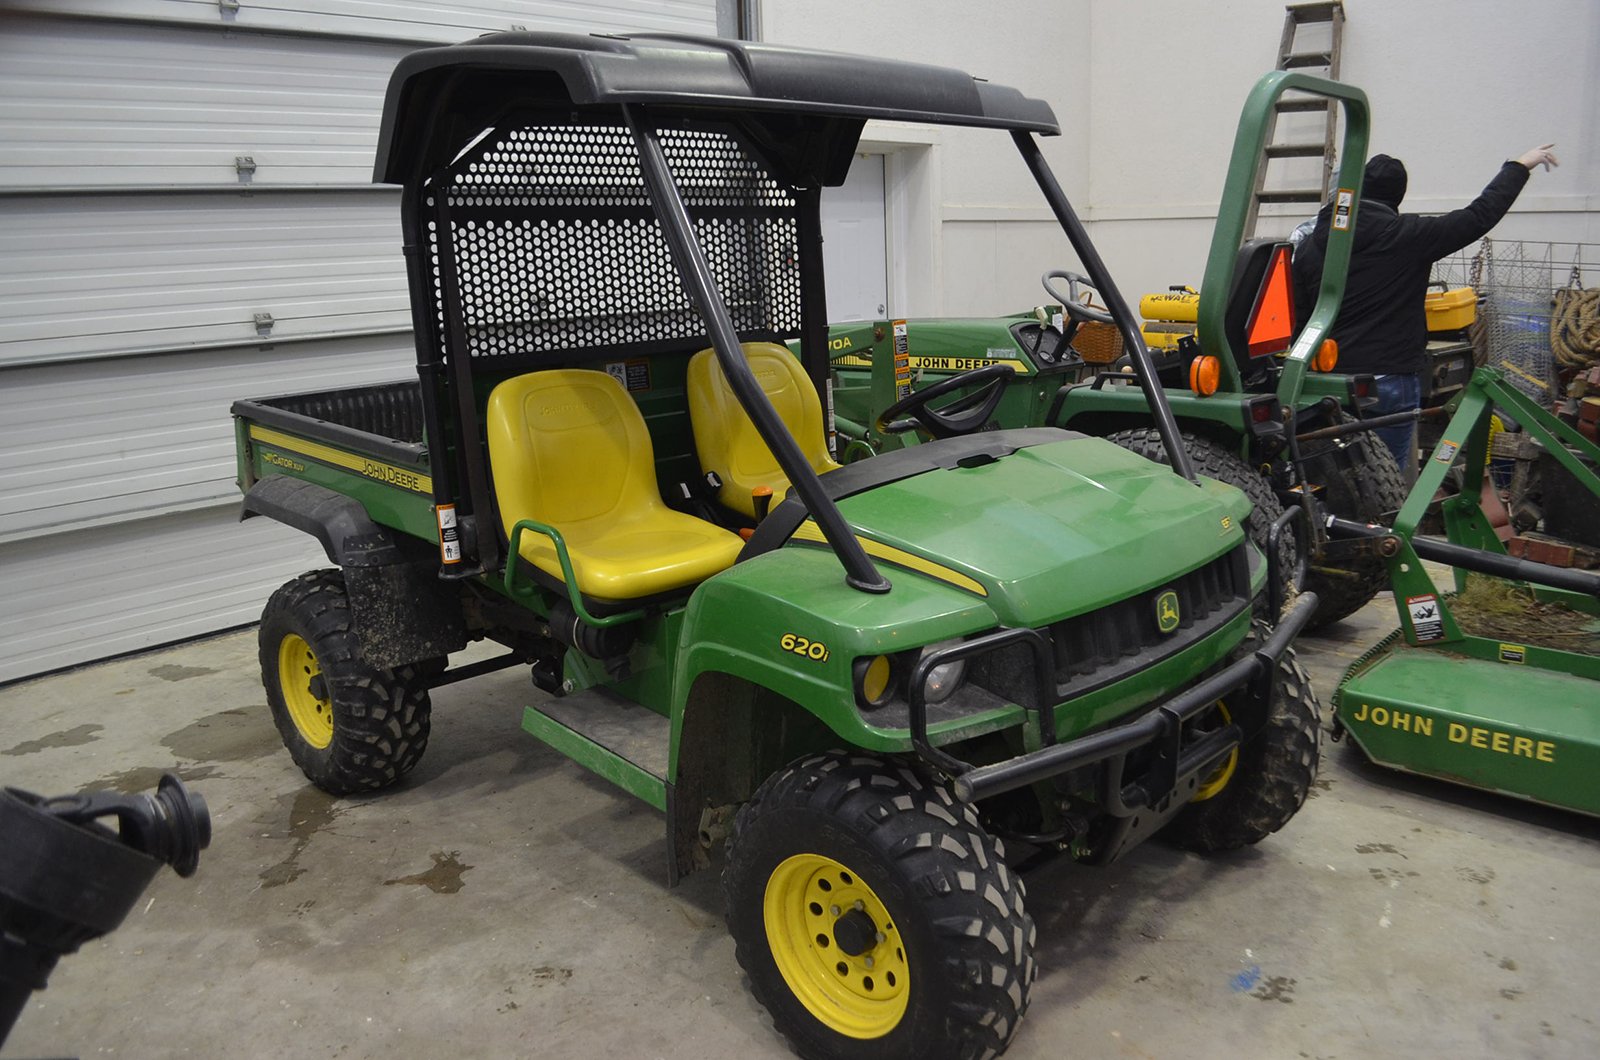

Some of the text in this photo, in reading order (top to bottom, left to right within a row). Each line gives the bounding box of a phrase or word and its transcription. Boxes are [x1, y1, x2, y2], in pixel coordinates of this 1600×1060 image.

[915, 357, 950, 369] JOHN
[362, 459, 420, 491] JOHN DEERE
[780, 633, 830, 663] 620i
[1354, 704, 1556, 763] JOHN DEERE
